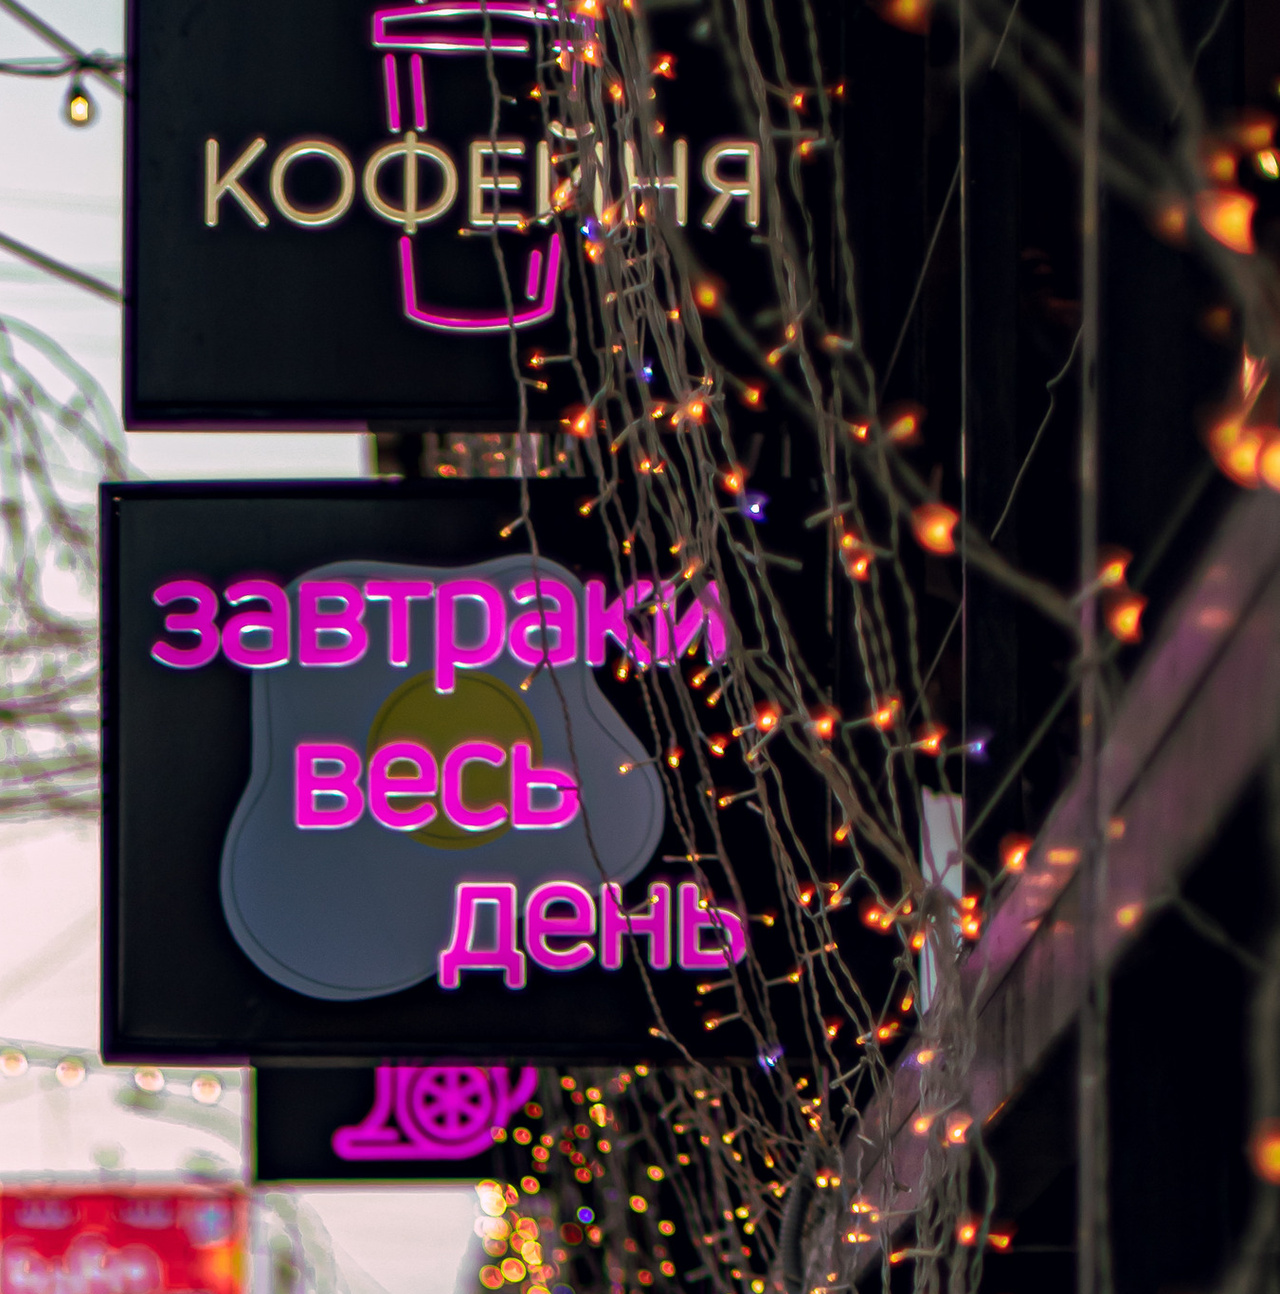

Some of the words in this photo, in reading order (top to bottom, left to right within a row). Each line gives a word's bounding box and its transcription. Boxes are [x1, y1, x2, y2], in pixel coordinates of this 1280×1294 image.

[150, 578, 728, 694] завтраки
[294, 741, 581, 831] весь
[438, 881, 748, 989] день
